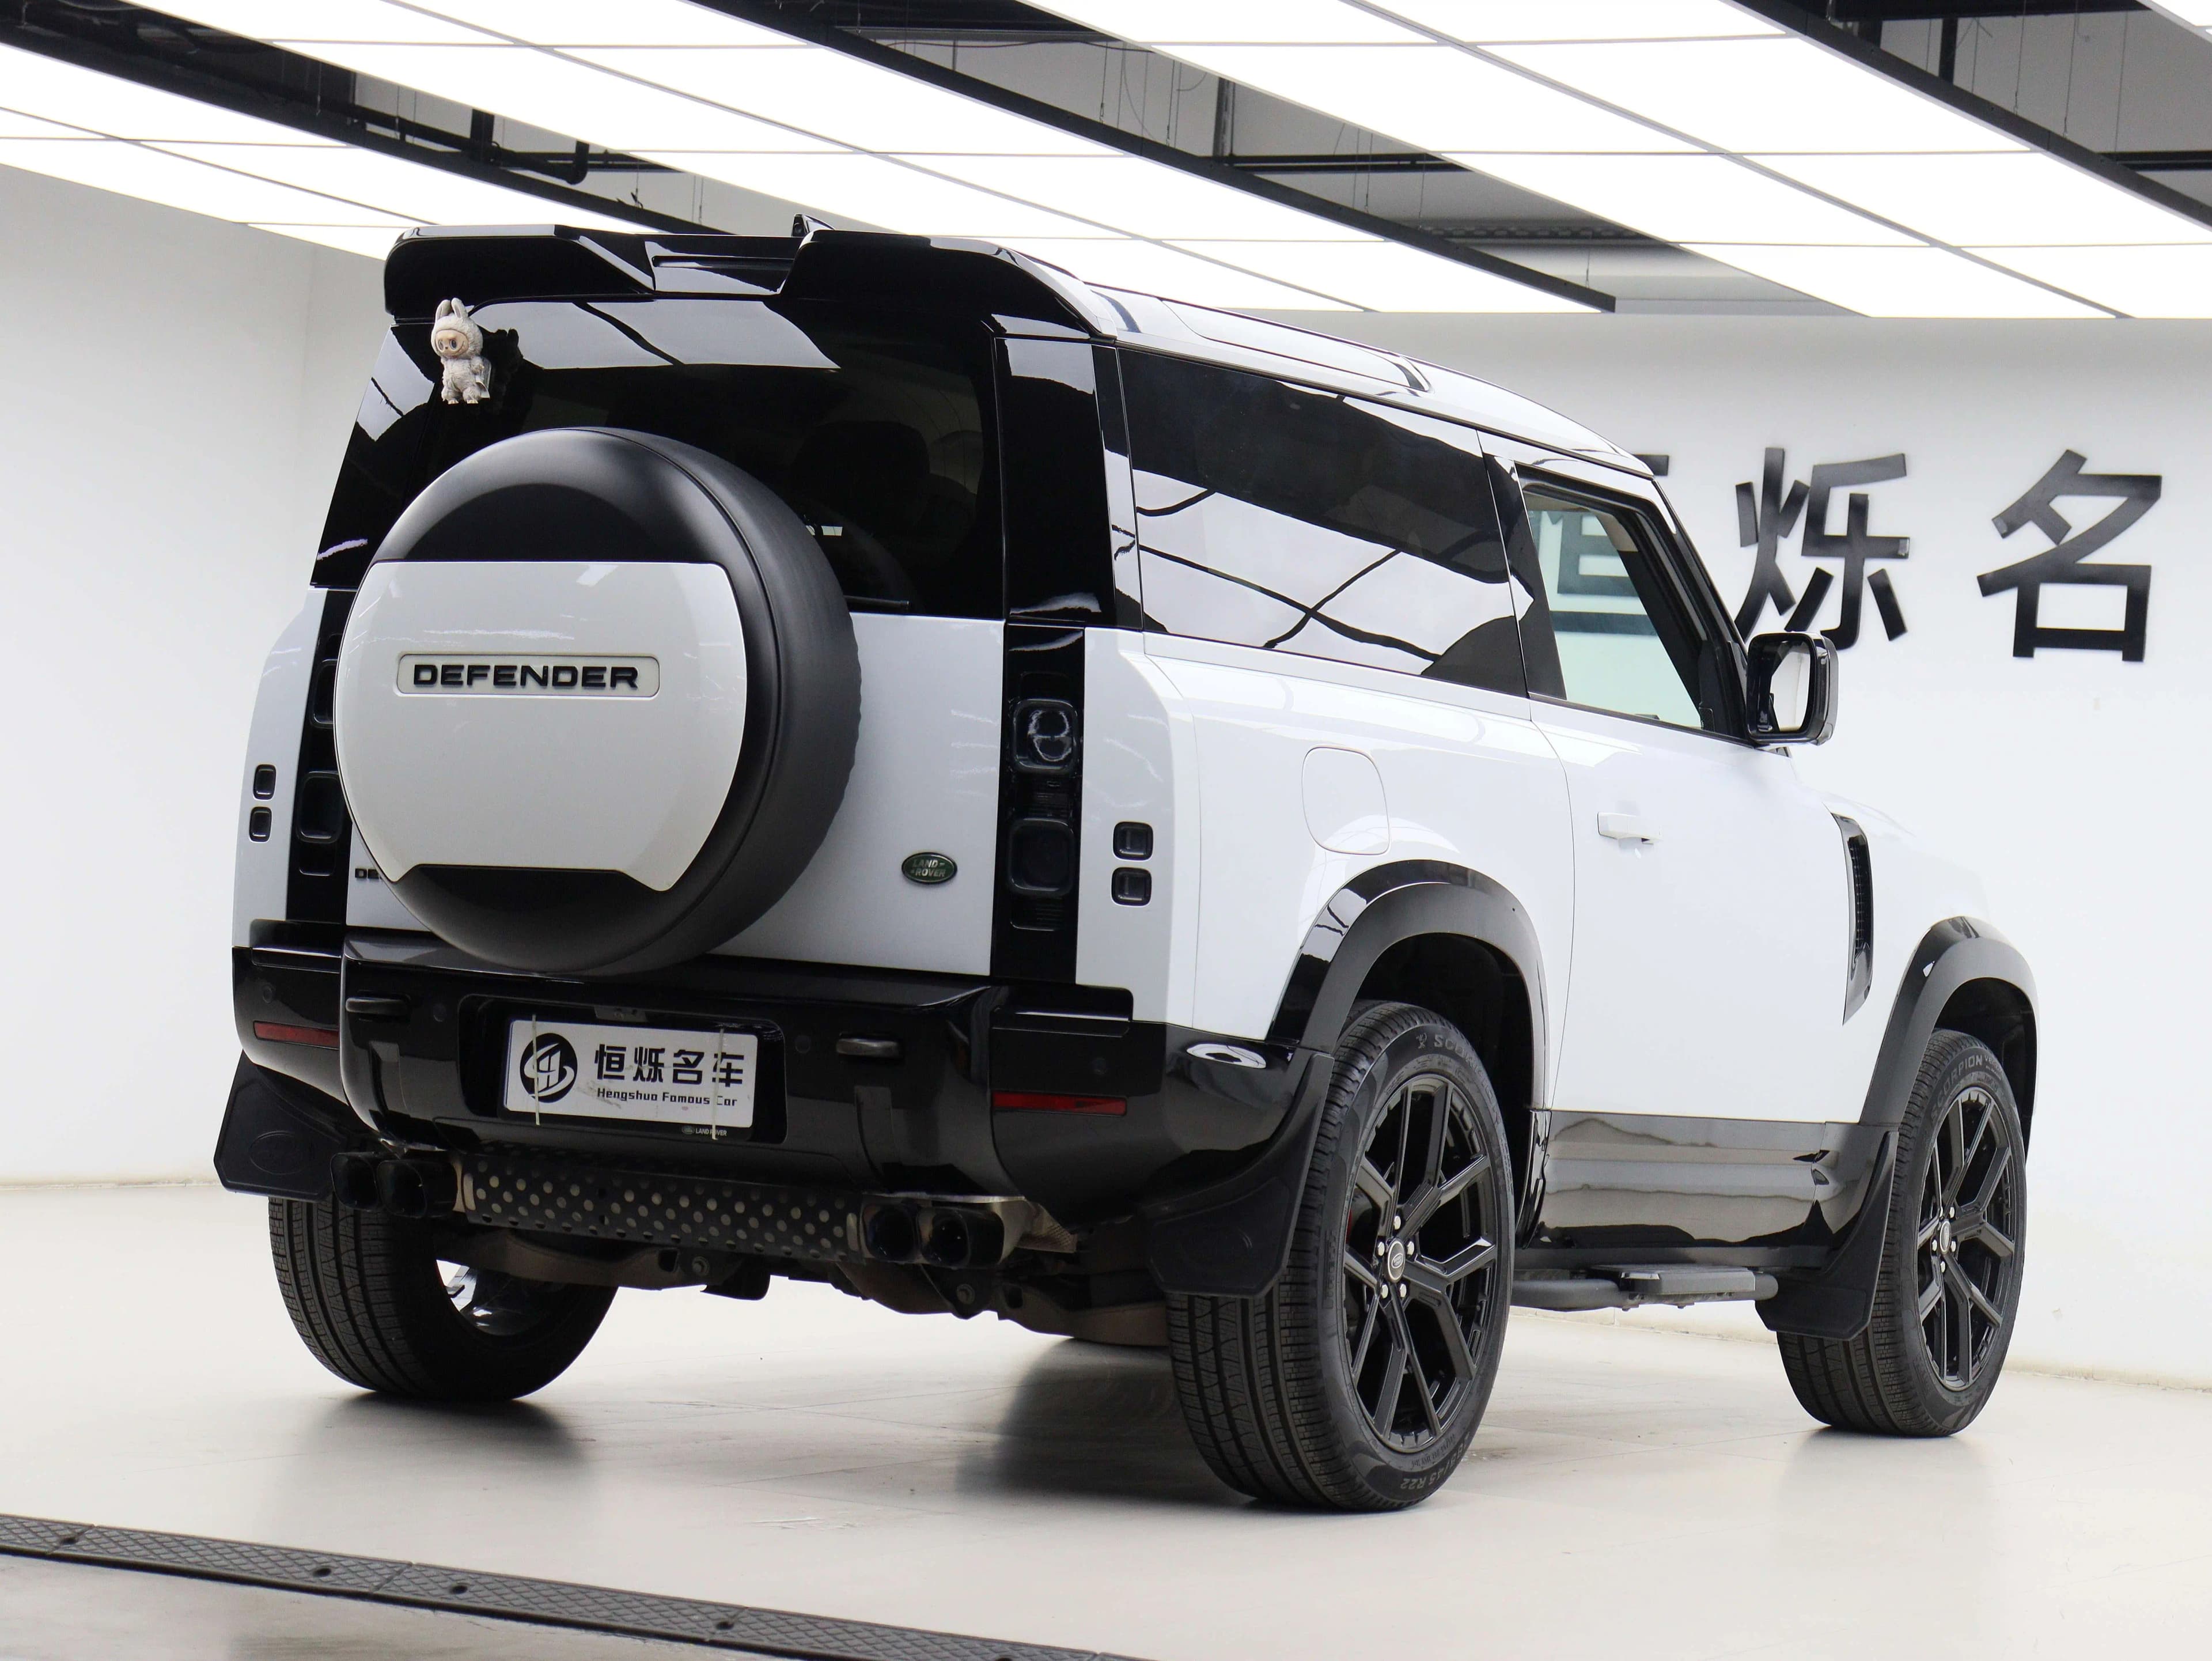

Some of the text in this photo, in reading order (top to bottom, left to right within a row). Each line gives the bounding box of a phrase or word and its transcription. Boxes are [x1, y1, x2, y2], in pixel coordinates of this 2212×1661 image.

[414, 664, 639, 689] DEFENDER
[594, 1043, 744, 1087] 恒烁名车
[597, 1088, 738, 1107] Hengshuo Famous Car
[695, 1127, 727, 1137] LAND RVER
[1400, 1476, 1427, 1490] R22
